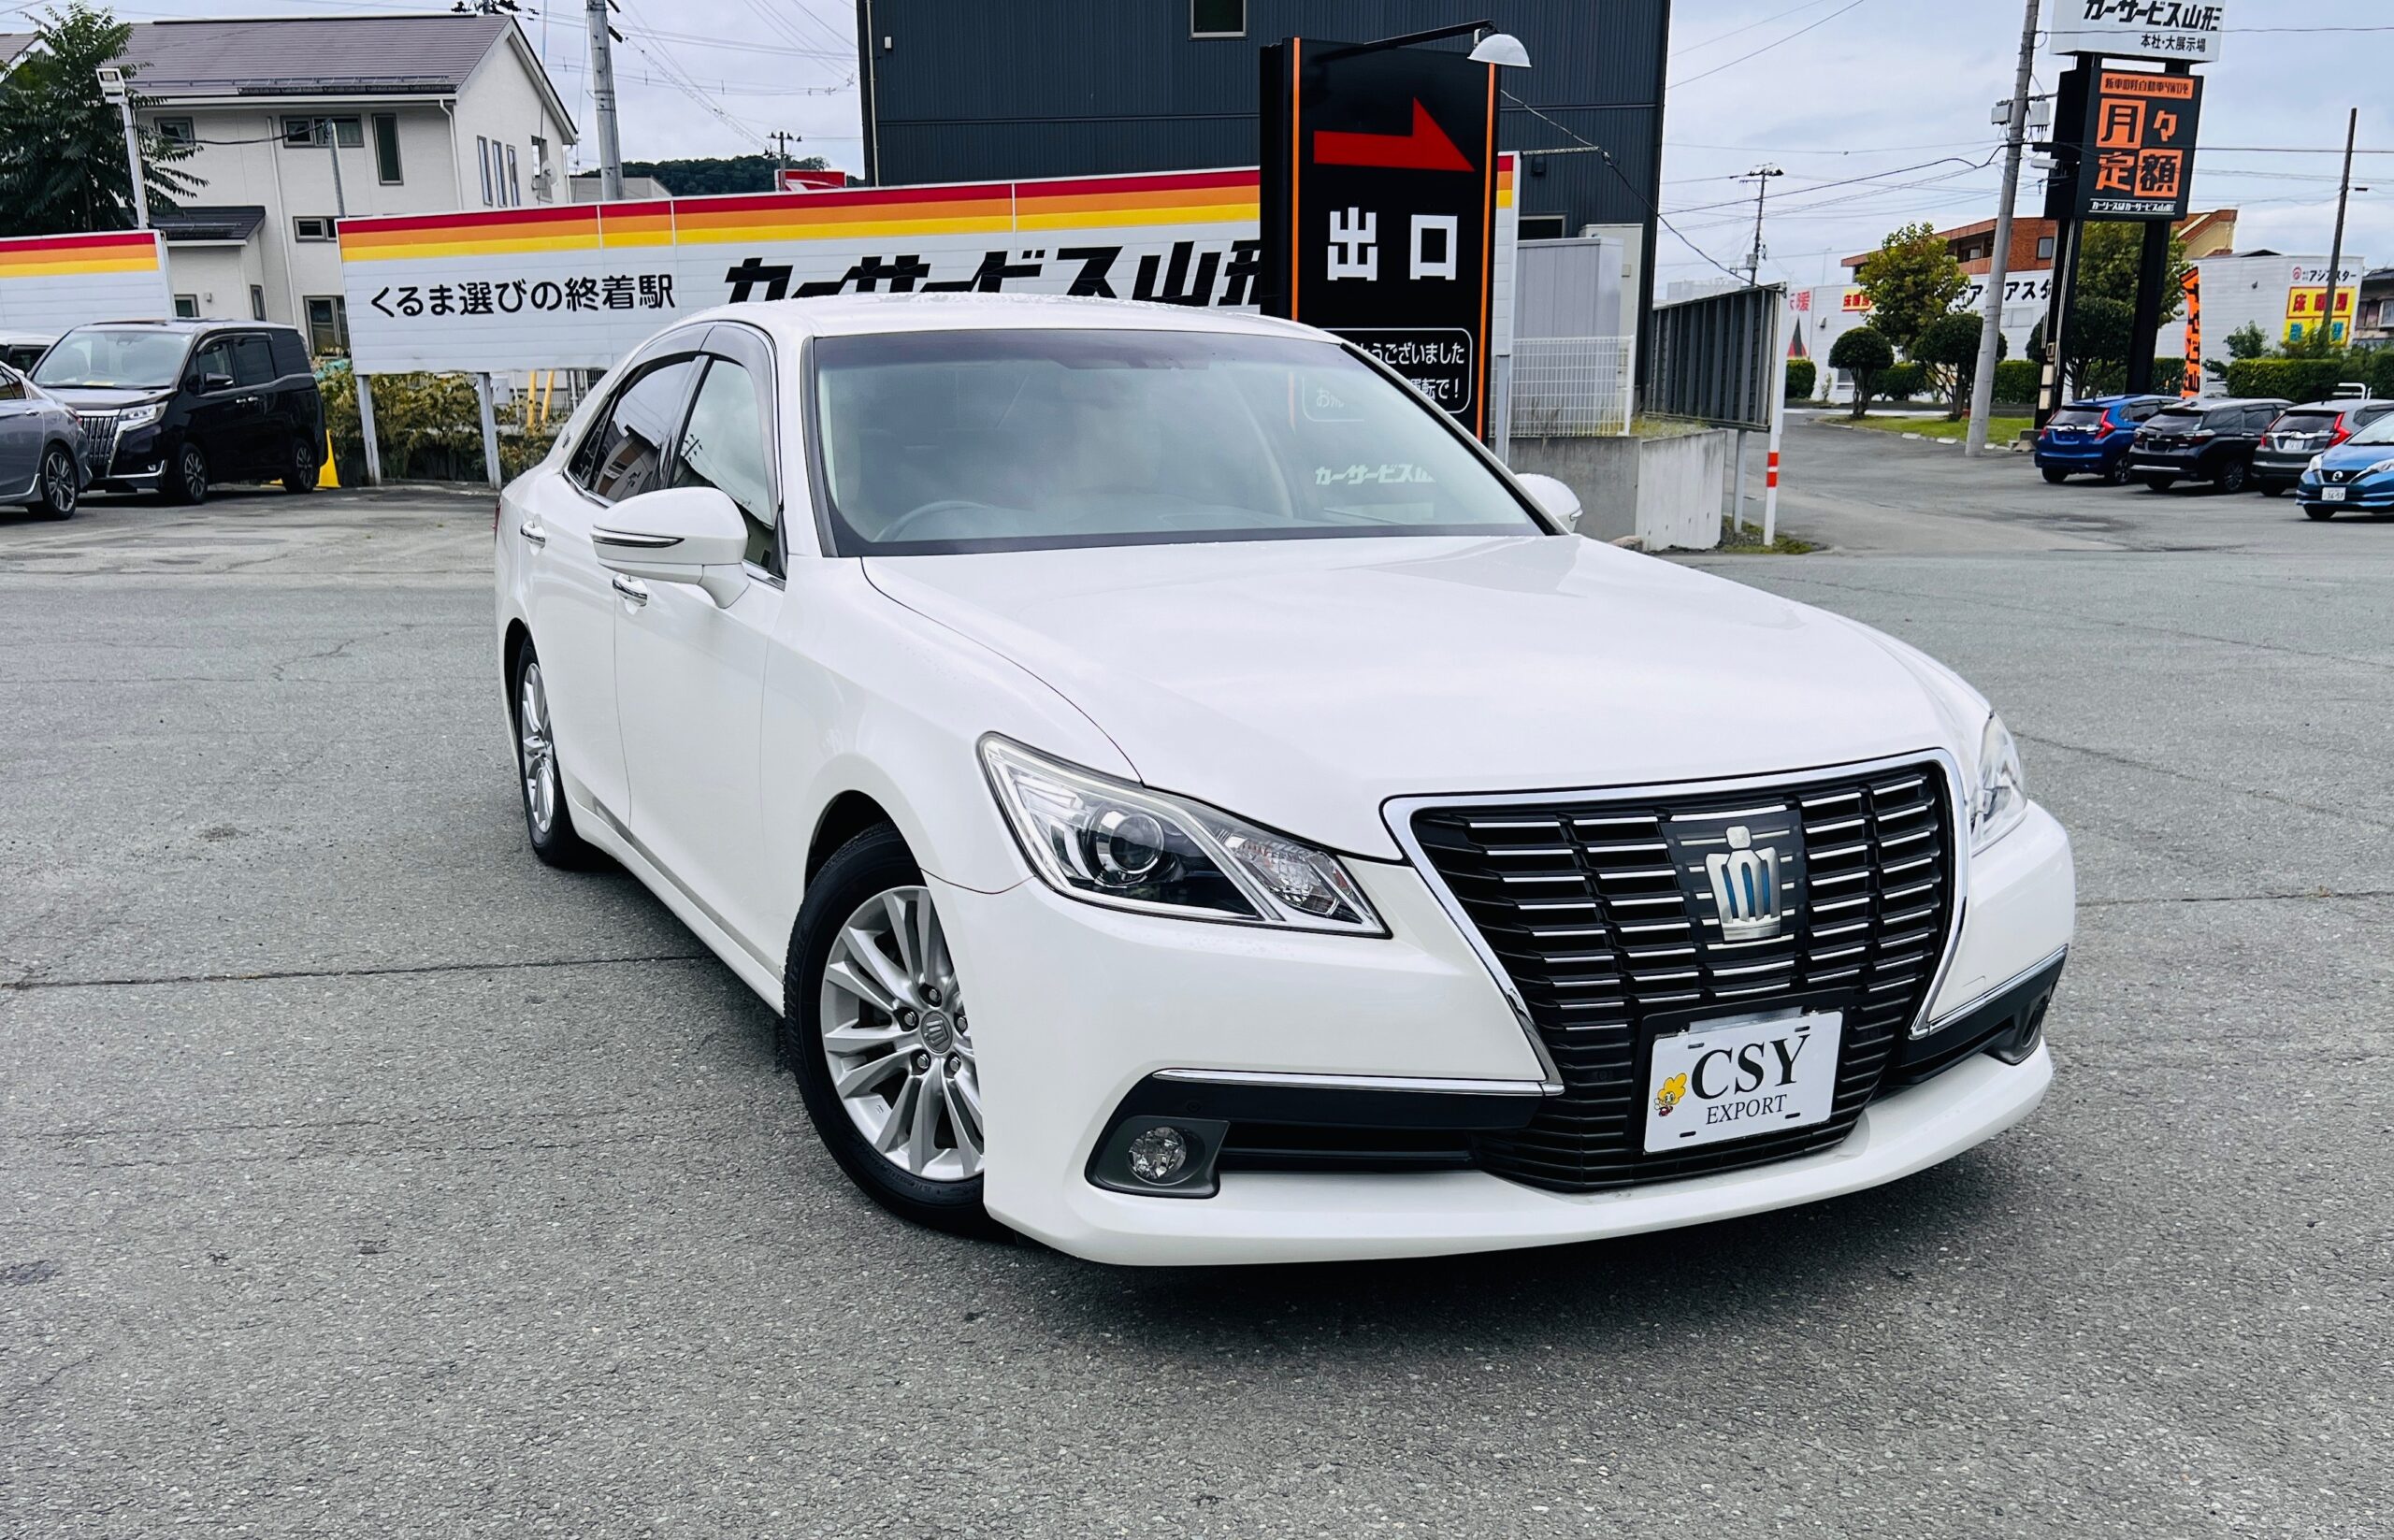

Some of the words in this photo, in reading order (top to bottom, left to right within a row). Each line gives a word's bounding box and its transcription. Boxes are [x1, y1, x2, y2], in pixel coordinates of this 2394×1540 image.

[2100, 104, 2178, 143] 月々
[2096, 151, 2178, 193] 定額
[1327, 207, 1458, 281] 出口
[371, 274, 675, 318] くるま選びの終着駅
[1691, 1033, 1810, 1100] CSY
[1705, 1093, 1788, 1125] EXPORT
